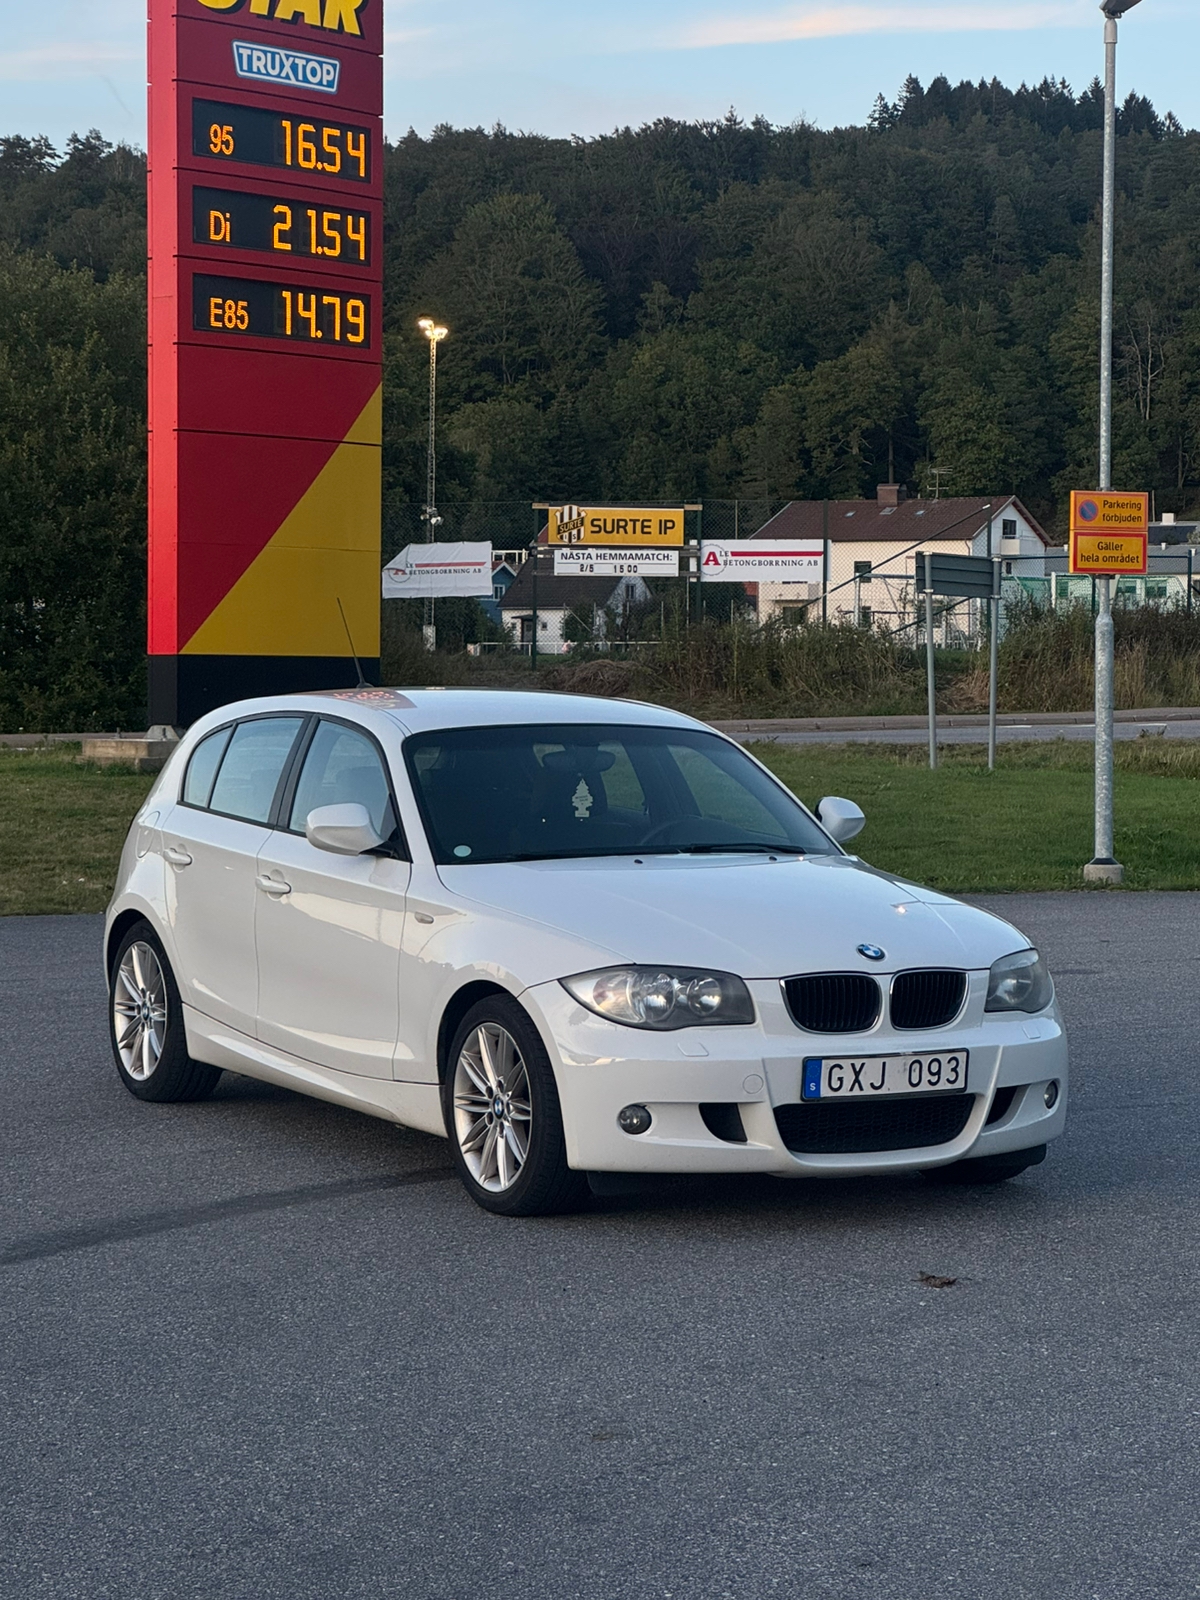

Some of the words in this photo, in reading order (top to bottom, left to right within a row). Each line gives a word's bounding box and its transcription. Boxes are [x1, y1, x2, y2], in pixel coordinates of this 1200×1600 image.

[238, 47, 335, 86] TRUXTOP
[209, 123, 235, 156] 95
[281, 120, 366, 178] 16.54
[209, 210, 231, 242] Di
[209, 297, 249, 330] E85
[281, 290, 365, 343] 14.79
[1102, 499, 1142, 511] Parkering
[1102, 513, 1142, 523] förbjuden
[559, 518, 582, 533] SURTE
[590, 518, 652, 535] SURTE
[658, 519, 676, 535] IP
[1097, 541, 1123, 551] Gäller
[560, 551, 593, 560] NÄSTA
[595, 552, 673, 561] HEMMAMATCH:
[1080, 553, 1100, 563] hela
[1102, 553, 1140, 564] området
[579, 563, 594, 573] 2/5
[723, 559, 804, 567] BETONGBORRNING
[807, 559, 819, 567] AB
[827, 1061, 887, 1093] GXJ
[908, 1056, 960, 1088] 093
[809, 1082, 816, 1091] S
